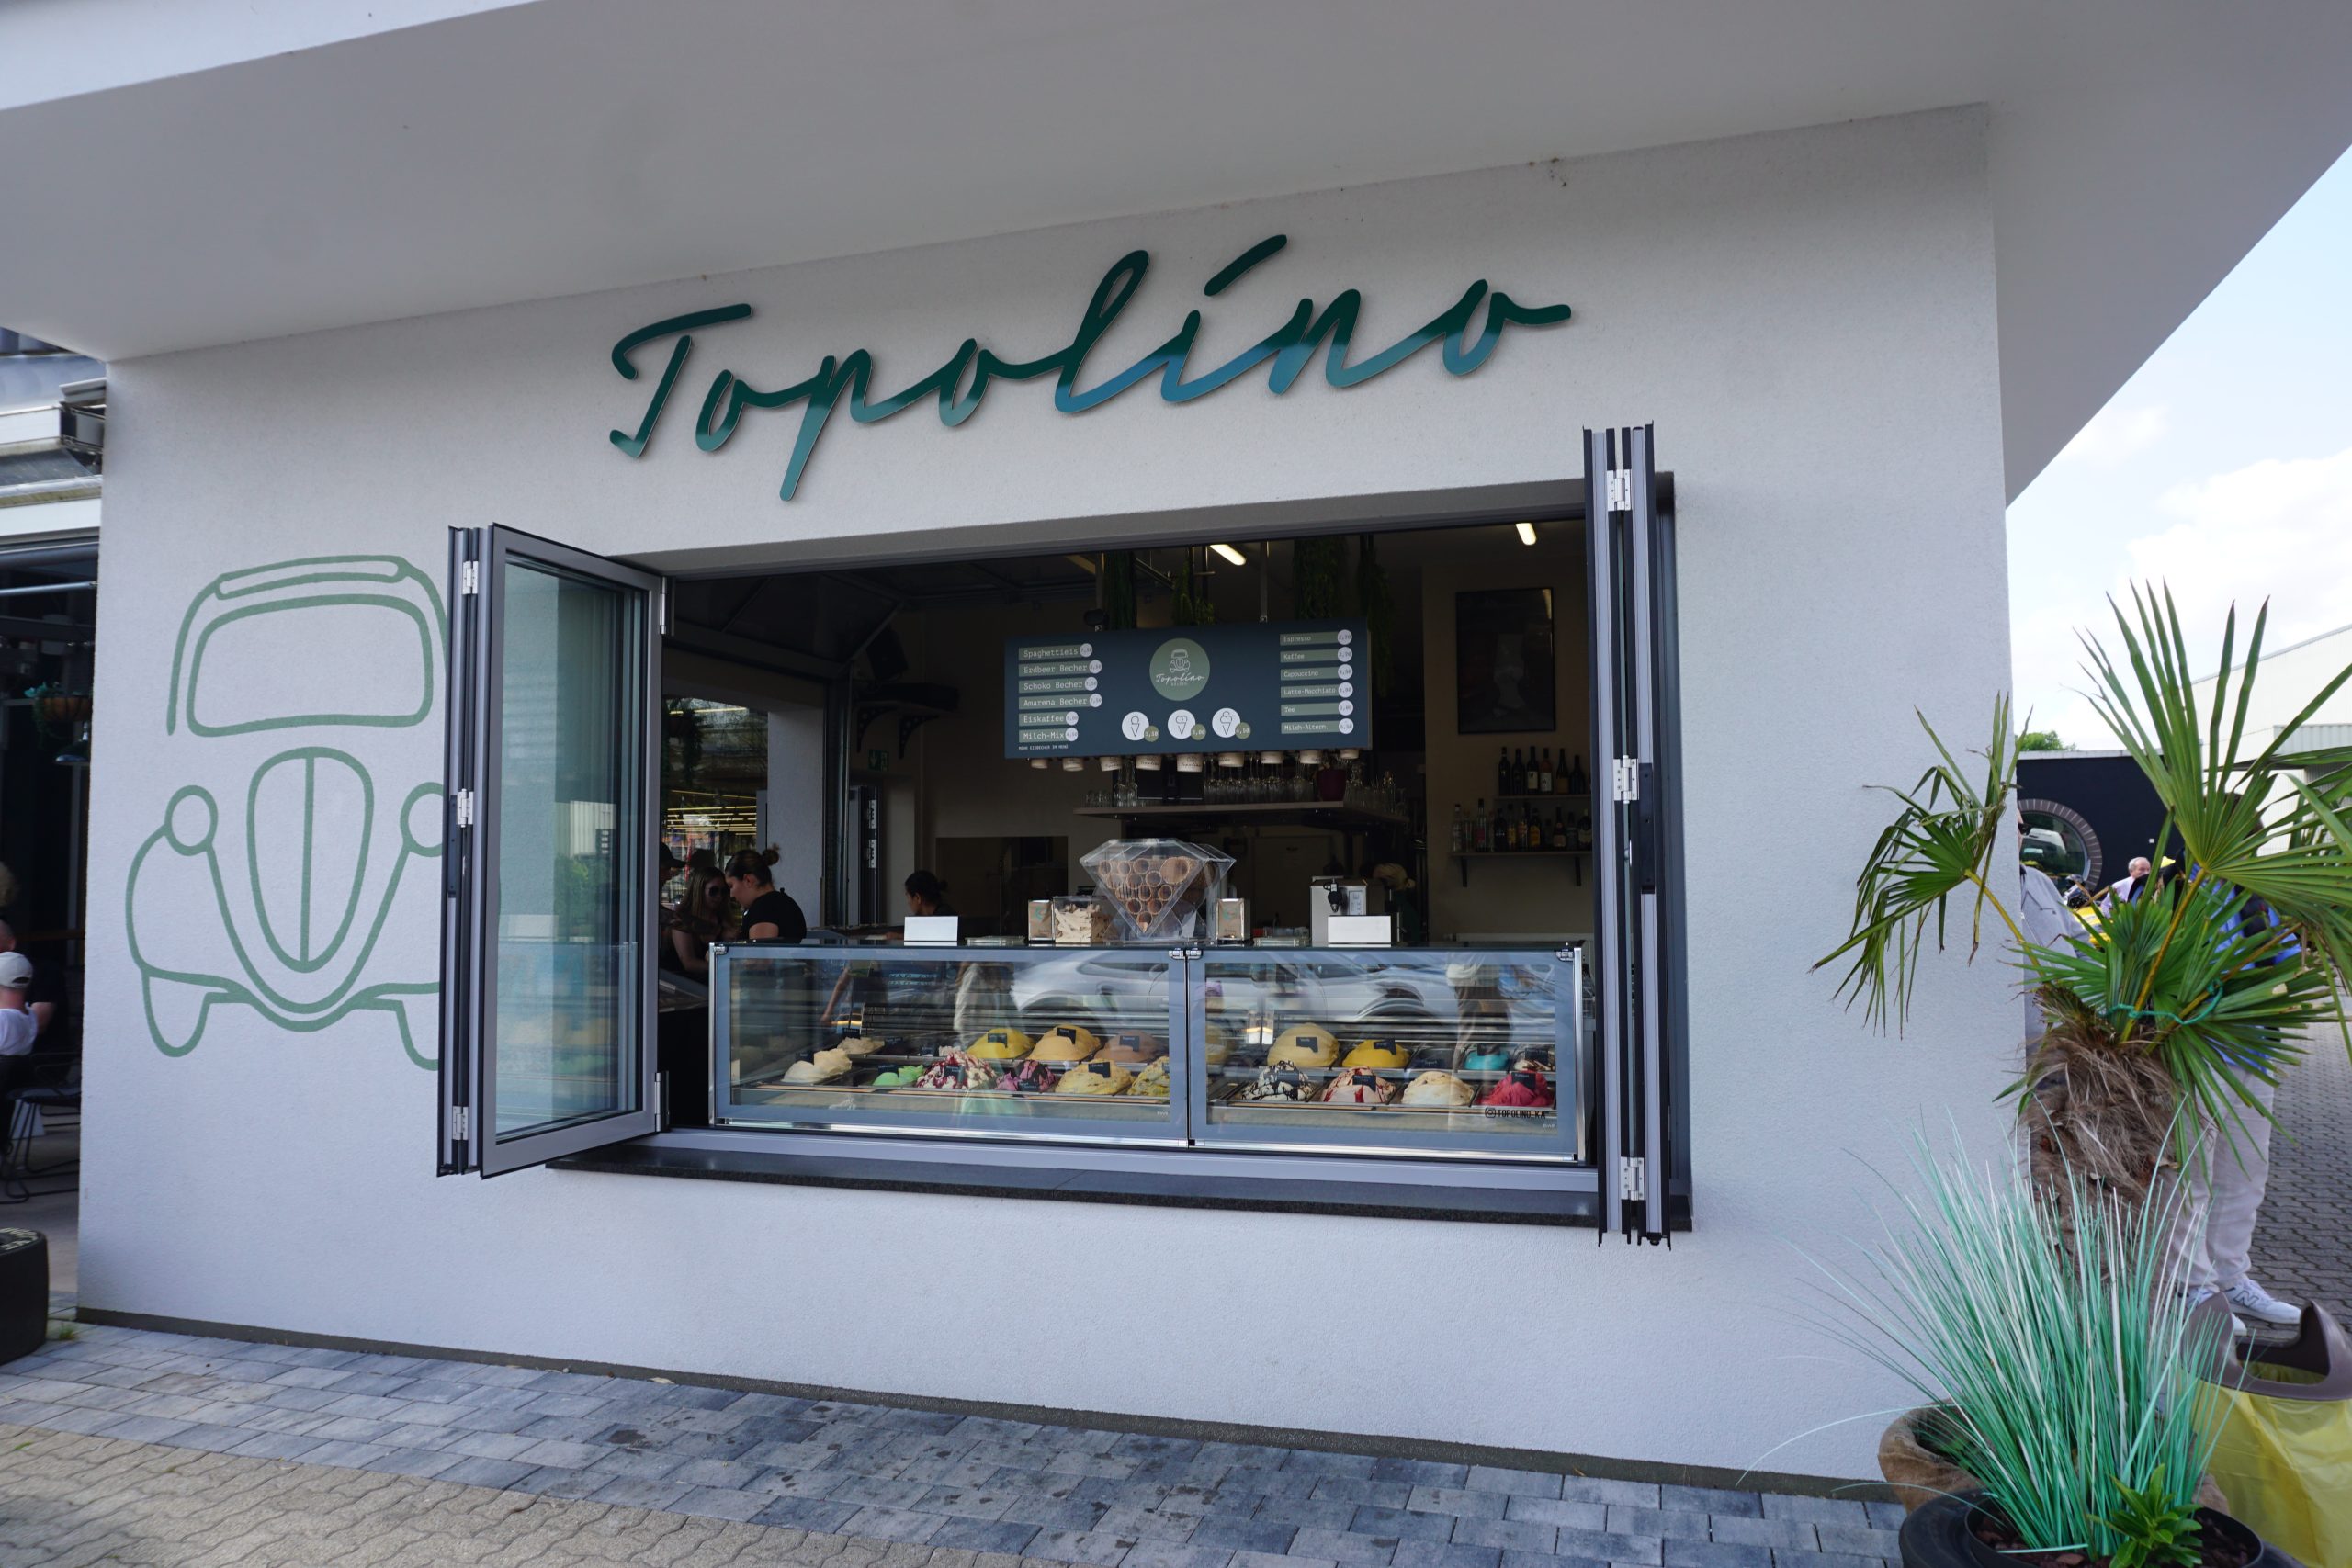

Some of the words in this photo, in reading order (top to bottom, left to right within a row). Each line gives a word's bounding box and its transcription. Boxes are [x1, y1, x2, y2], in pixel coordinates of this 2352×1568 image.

[610, 233, 1572, 501] Topolino
[1023, 649, 1079, 659] Spaghettieis
[1023, 666, 1056, 674] Erdbeer
[1059, 664, 1088, 672] Becher
[1023, 682, 1051, 691] Schoko
[1055, 681, 1083, 689] Becher
[1283, 687, 1336, 695] Latte-Macchiato
[1023, 715, 1064, 723] Eiskaffee
[1023, 731, 1065, 740] Milch-Mix
